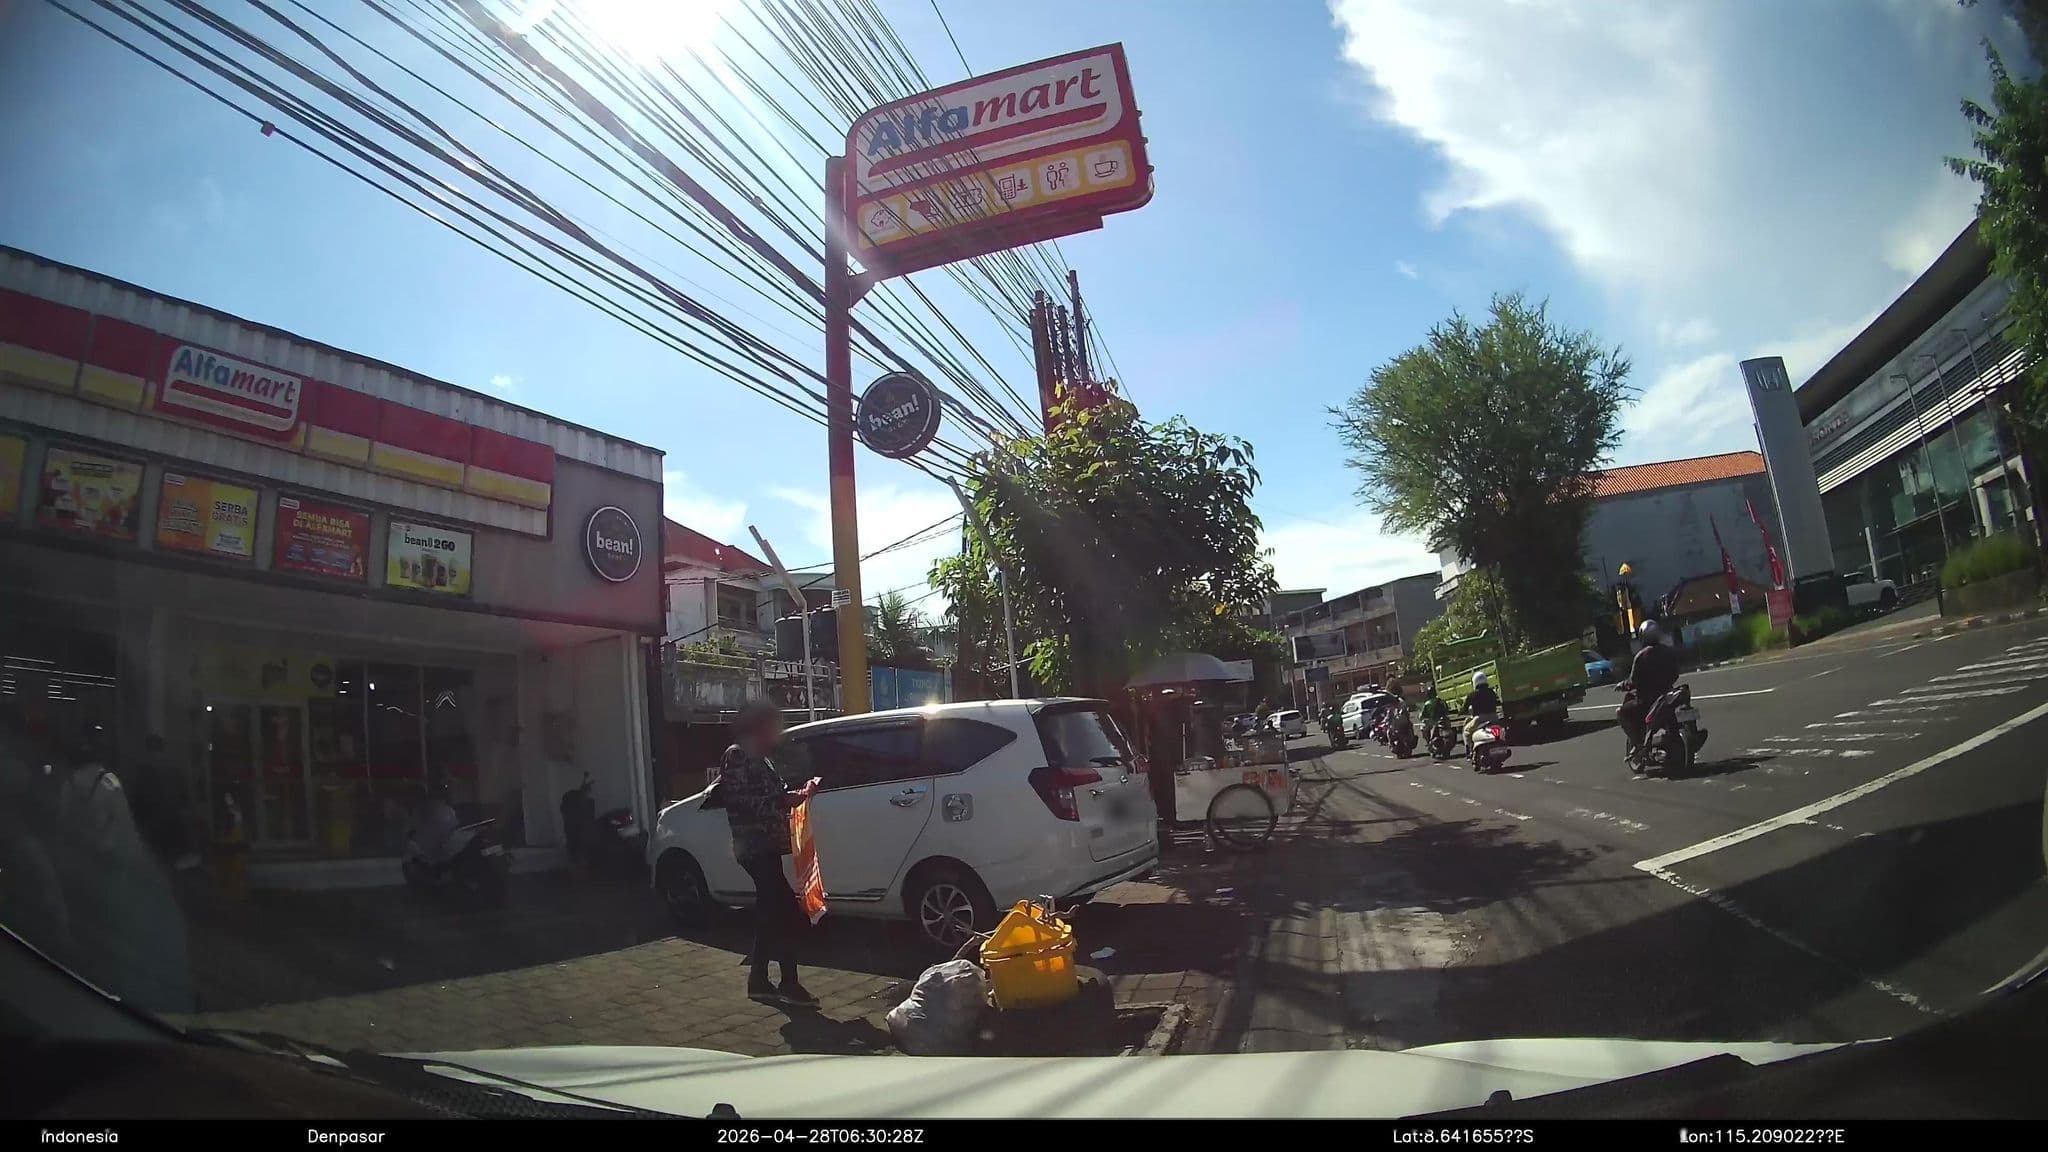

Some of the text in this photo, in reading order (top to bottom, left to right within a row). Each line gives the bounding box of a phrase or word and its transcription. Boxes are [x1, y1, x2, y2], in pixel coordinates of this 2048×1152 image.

[867, 68, 1102, 156] Alfamart
[173, 349, 296, 402] Alfamart
[868, 393, 920, 431] bean!
[215, 501, 248, 515] SERBA
[296, 511, 326, 524] SEMUA
[434, 539, 456, 551] 2GO
[596, 530, 633, 555] bean!
